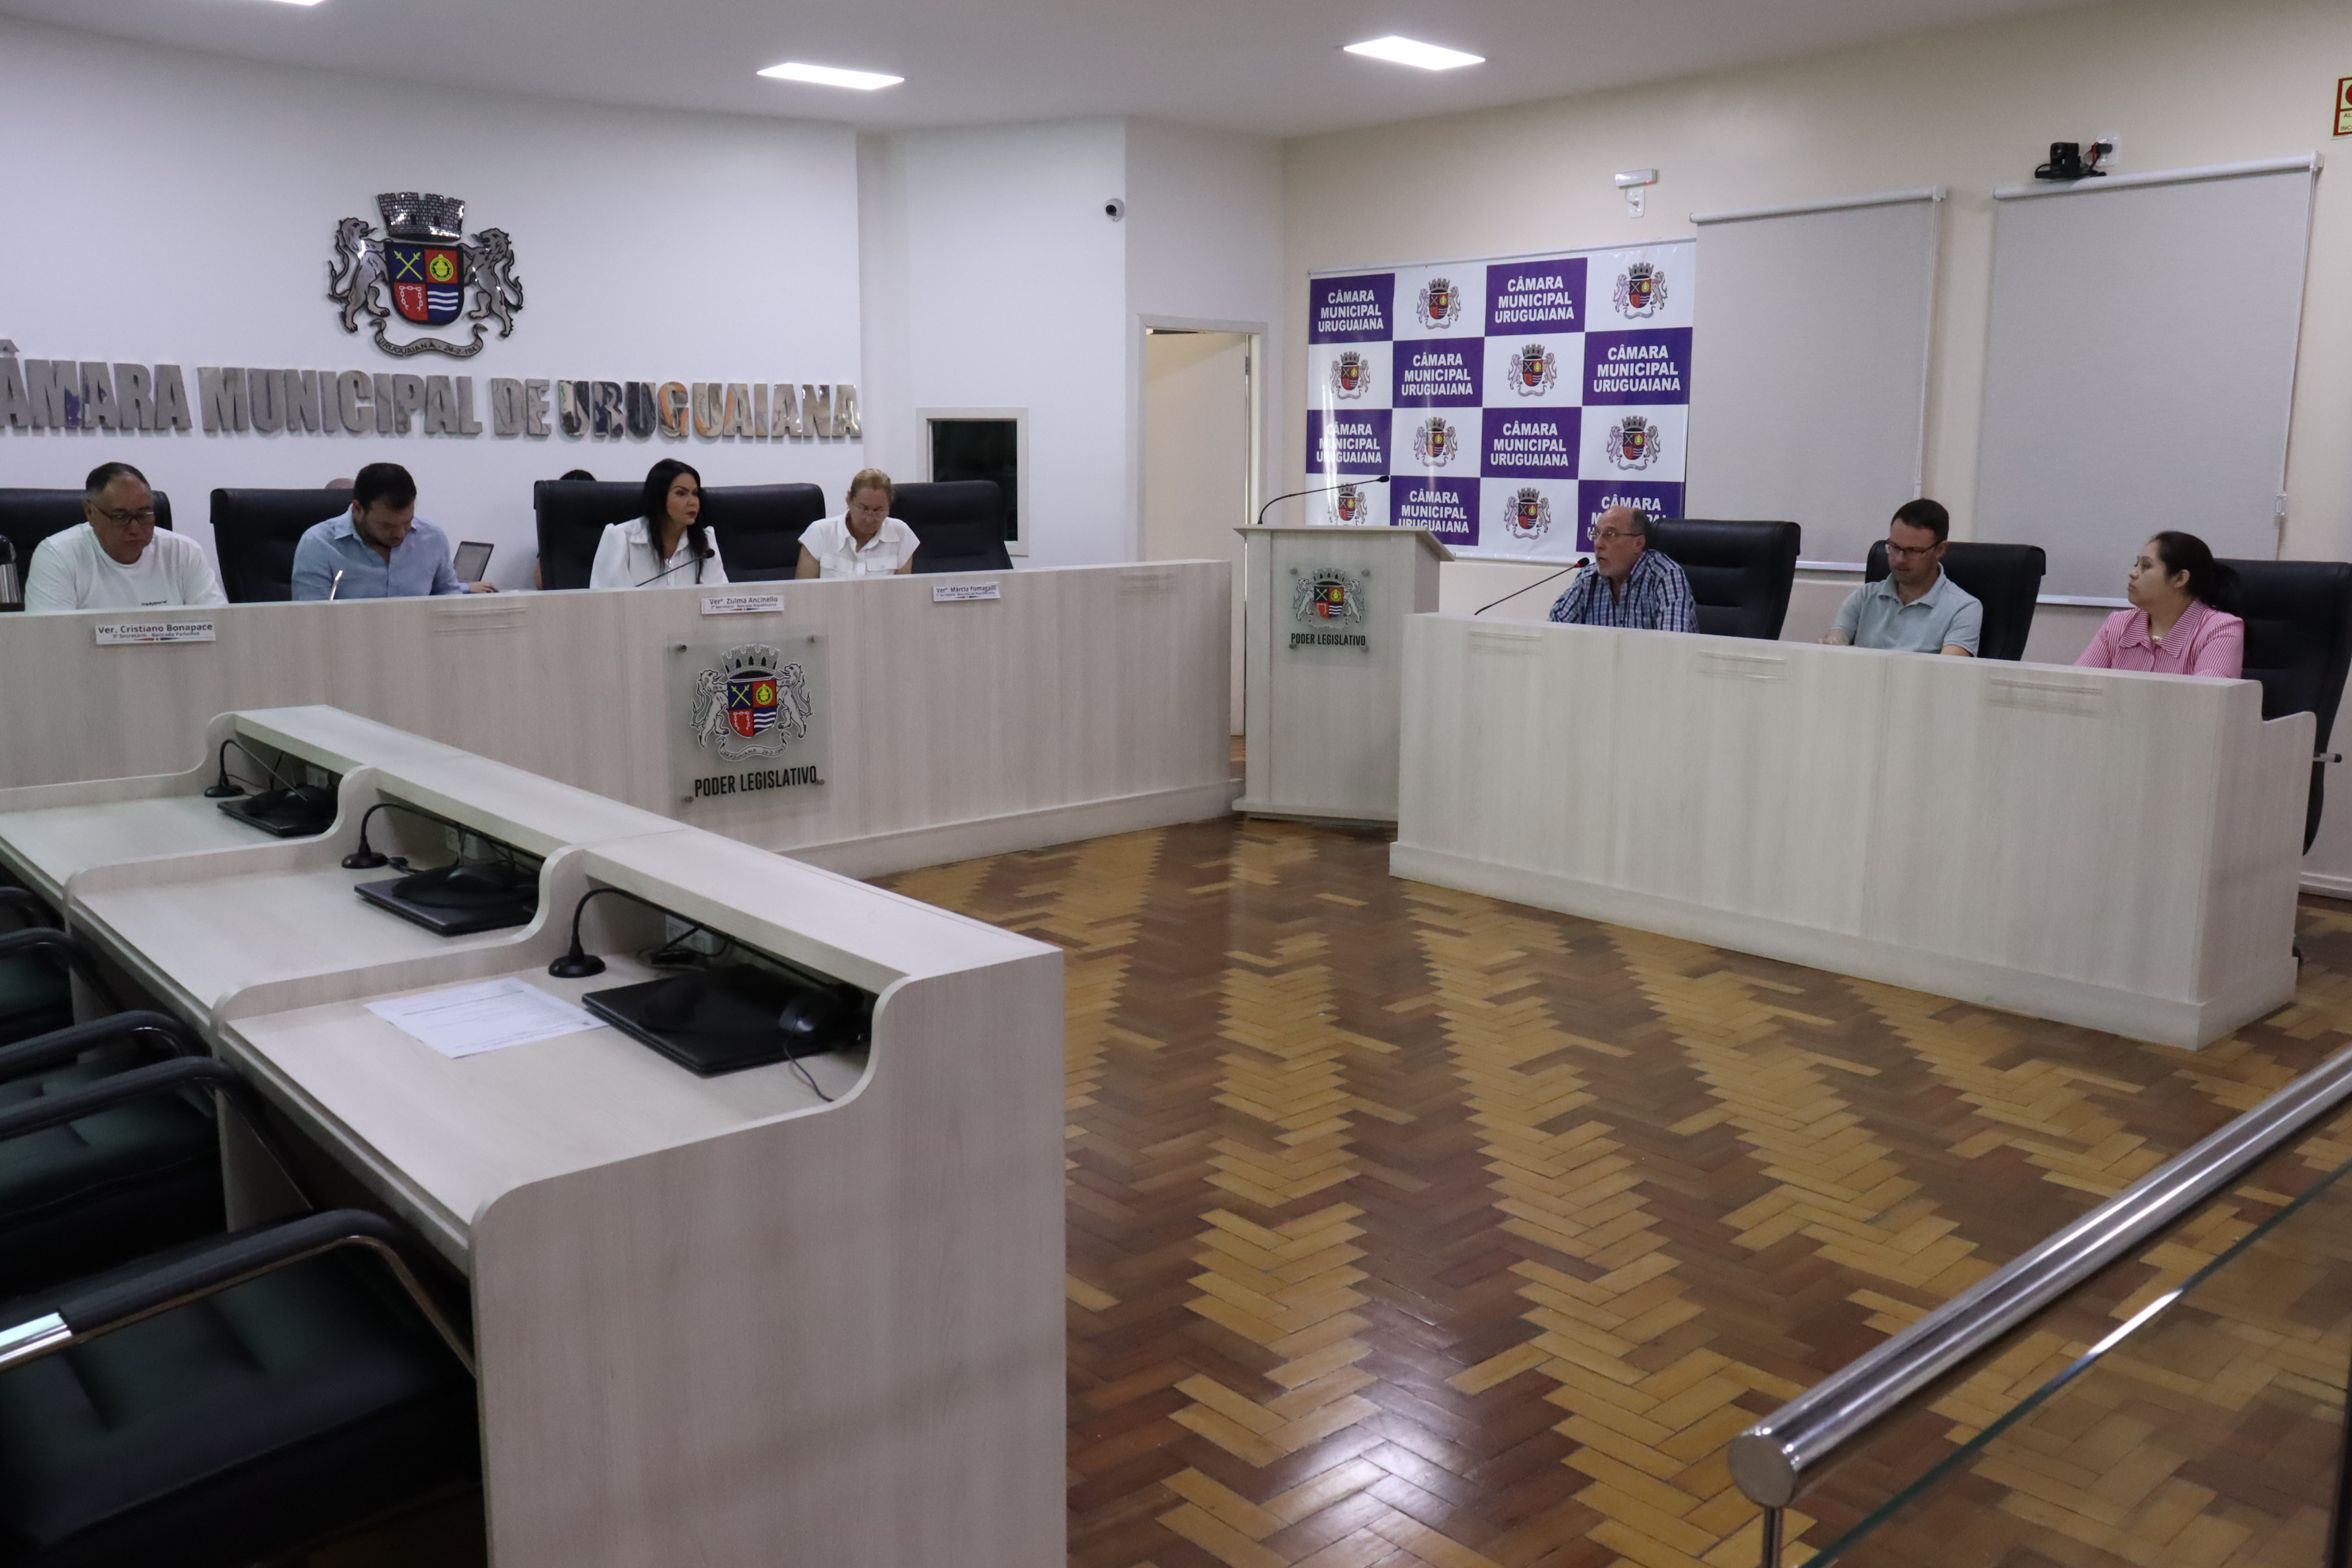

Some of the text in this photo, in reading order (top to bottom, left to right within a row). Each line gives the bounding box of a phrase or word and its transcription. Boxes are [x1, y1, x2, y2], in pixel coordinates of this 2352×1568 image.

[1507, 276, 1563, 292] CÂMARA
[1328, 289, 1374, 304] CÂMARA
[1498, 292, 1572, 309] MUNICIPAL
[1321, 304, 1381, 319] MUNICIPAL
[1494, 307, 1574, 323] URUGUAIANA
[1318, 318, 1384, 333] URUGUAIANA
[379, 337, 435, 355] URUGUAIANA
[1608, 344, 1668, 360] CÂMARA
[1412, 352, 1463, 368] CÂMARA
[1404, 368, 1471, 383] MUNICIPAL
[1597, 362, 1678, 378] MUNICIPAL
[1401, 381, 1473, 396] URUGUAIANA
[1593, 377, 1681, 393] URUGUAIANA
[197, 367, 483, 434] MUNICIPAL
[491, 377, 552, 435] DE
[557, 380, 862, 438] URUGUAIANA
[1326, 422, 1373, 435] CÂMARA
[1502, 420, 1558, 435] CÂMARA
[1318, 437, 1381, 450] MUNICIPAL
[1494, 439, 1566, 452] MUNICIPAL
[1316, 451, 1382, 464] URUGUAIANA
[1490, 453, 1569, 466] URUGUAIANA
[1409, 488, 1459, 504] CÂMARA
[1401, 505, 1467, 519] MUNICIPAL
[167, 624, 213, 632] Bonapace
[1291, 633, 1366, 646] PODER LEGISLATIVO
[695, 765, 817, 797] PODER LEGISLATIVO
